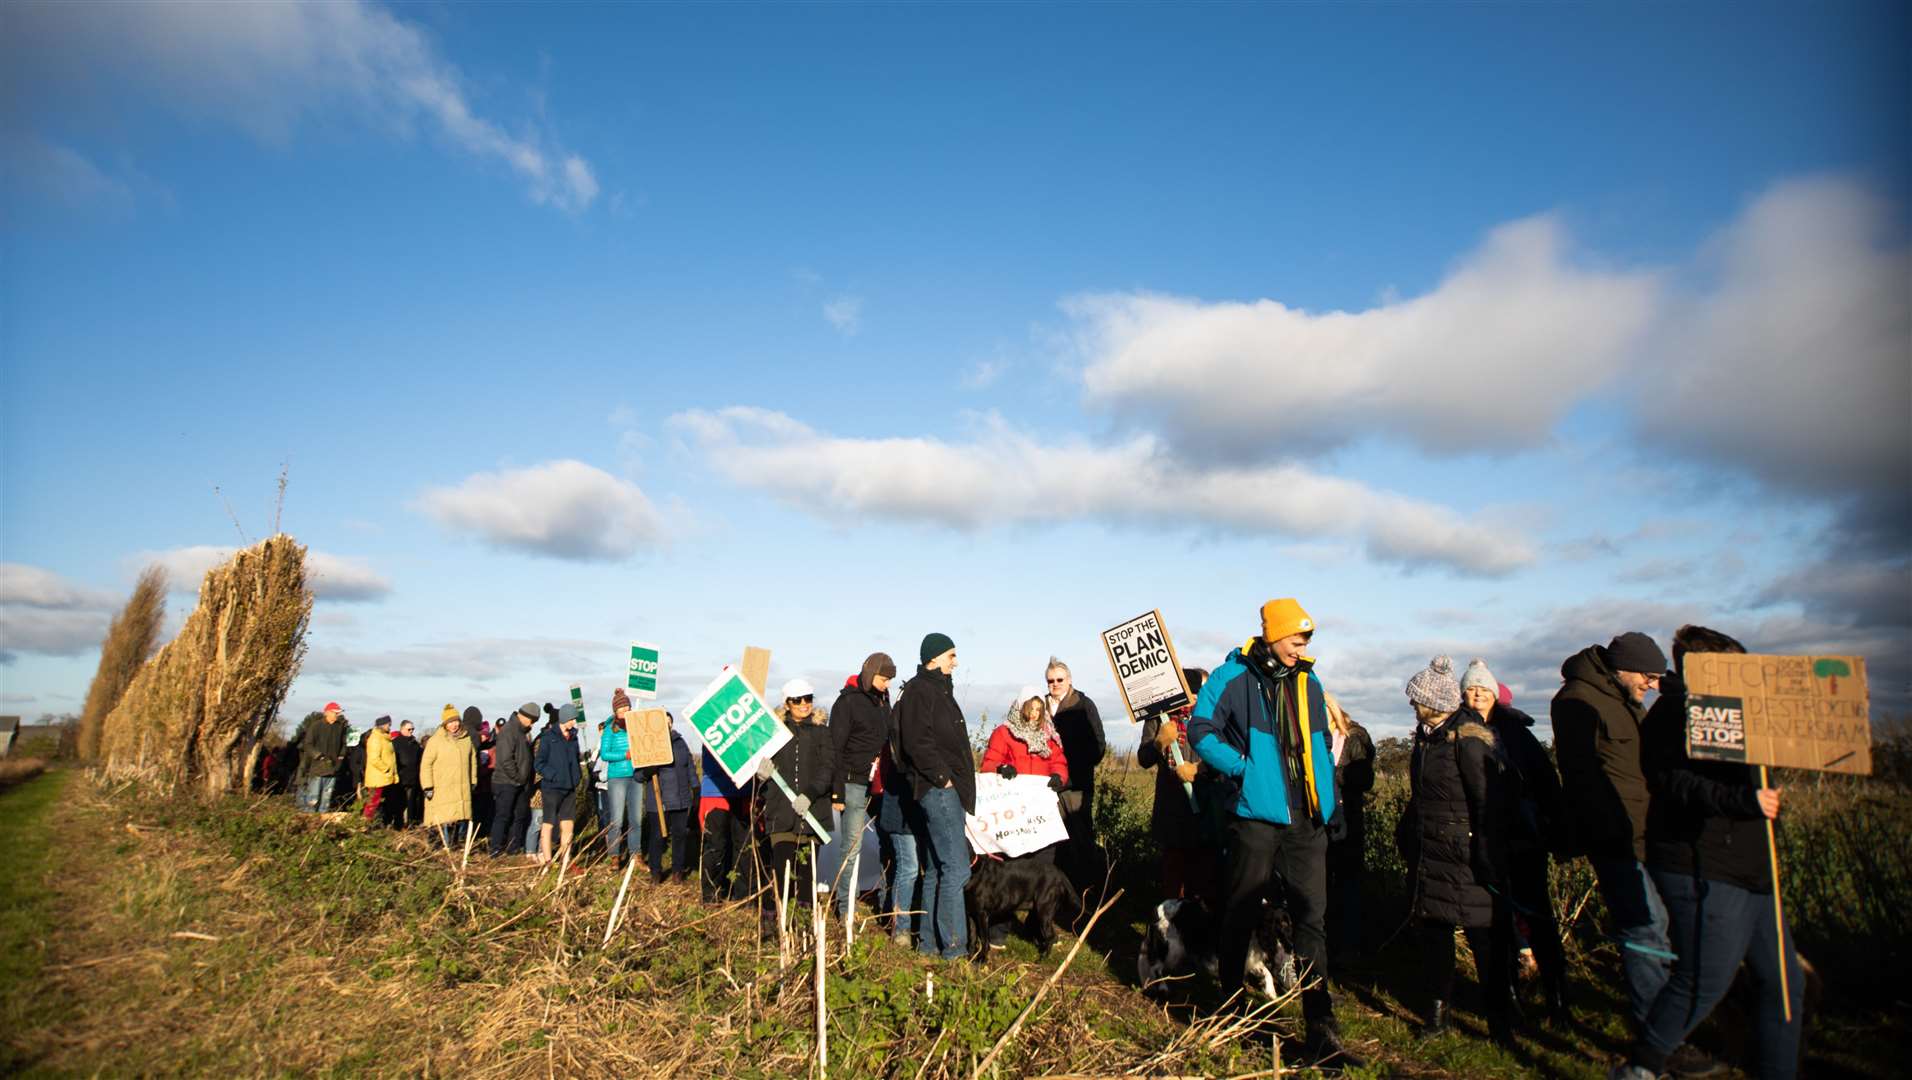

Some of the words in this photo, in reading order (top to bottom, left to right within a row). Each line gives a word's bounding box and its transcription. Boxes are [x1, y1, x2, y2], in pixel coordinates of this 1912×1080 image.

[1109, 626, 1134, 645] STOP
[1135, 617, 1156, 633] THE
[1112, 629, 1163, 663] PLAN
[631, 658, 657, 672] STOP
[1119, 648, 1168, 679] DEMIC
[1702, 658, 1777, 688] STOP
[704, 692, 754, 746] STOP
[1690, 705, 1742, 723] SAVE
[1691, 727, 1744, 743] STOP
[1753, 717, 1867, 742] FAVERSHAM
